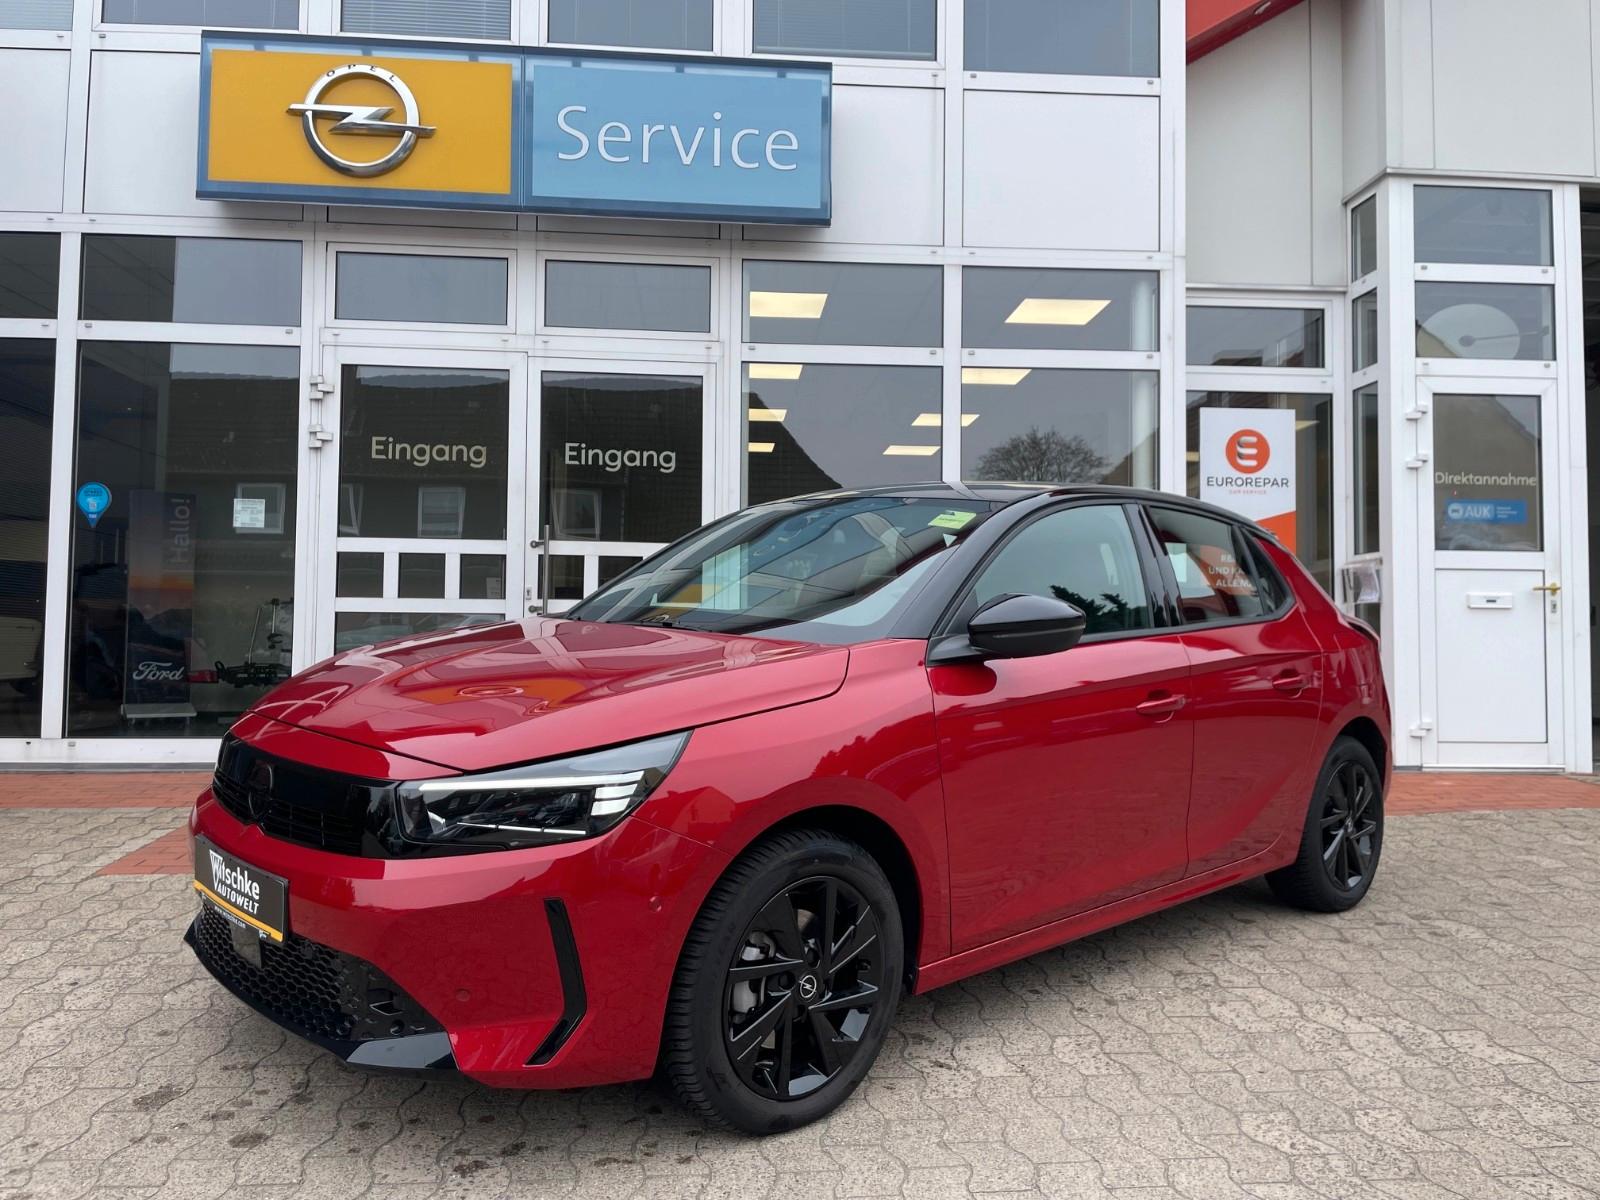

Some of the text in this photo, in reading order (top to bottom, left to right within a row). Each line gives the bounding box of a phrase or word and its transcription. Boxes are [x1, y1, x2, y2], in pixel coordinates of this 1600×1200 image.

[326, 63, 396, 82] OPEL
[557, 105, 799, 171] Service
[371, 436, 487, 468] Eingang
[564, 442, 676, 473] Eingang
[1206, 476, 1290, 488] EUROREPAR
[1434, 471, 1537, 487] Direktannahme
[169, 497, 191, 563] Hallo!
[132, 661, 185, 681] Ford
[216, 882, 260, 915] AUTOWELT
